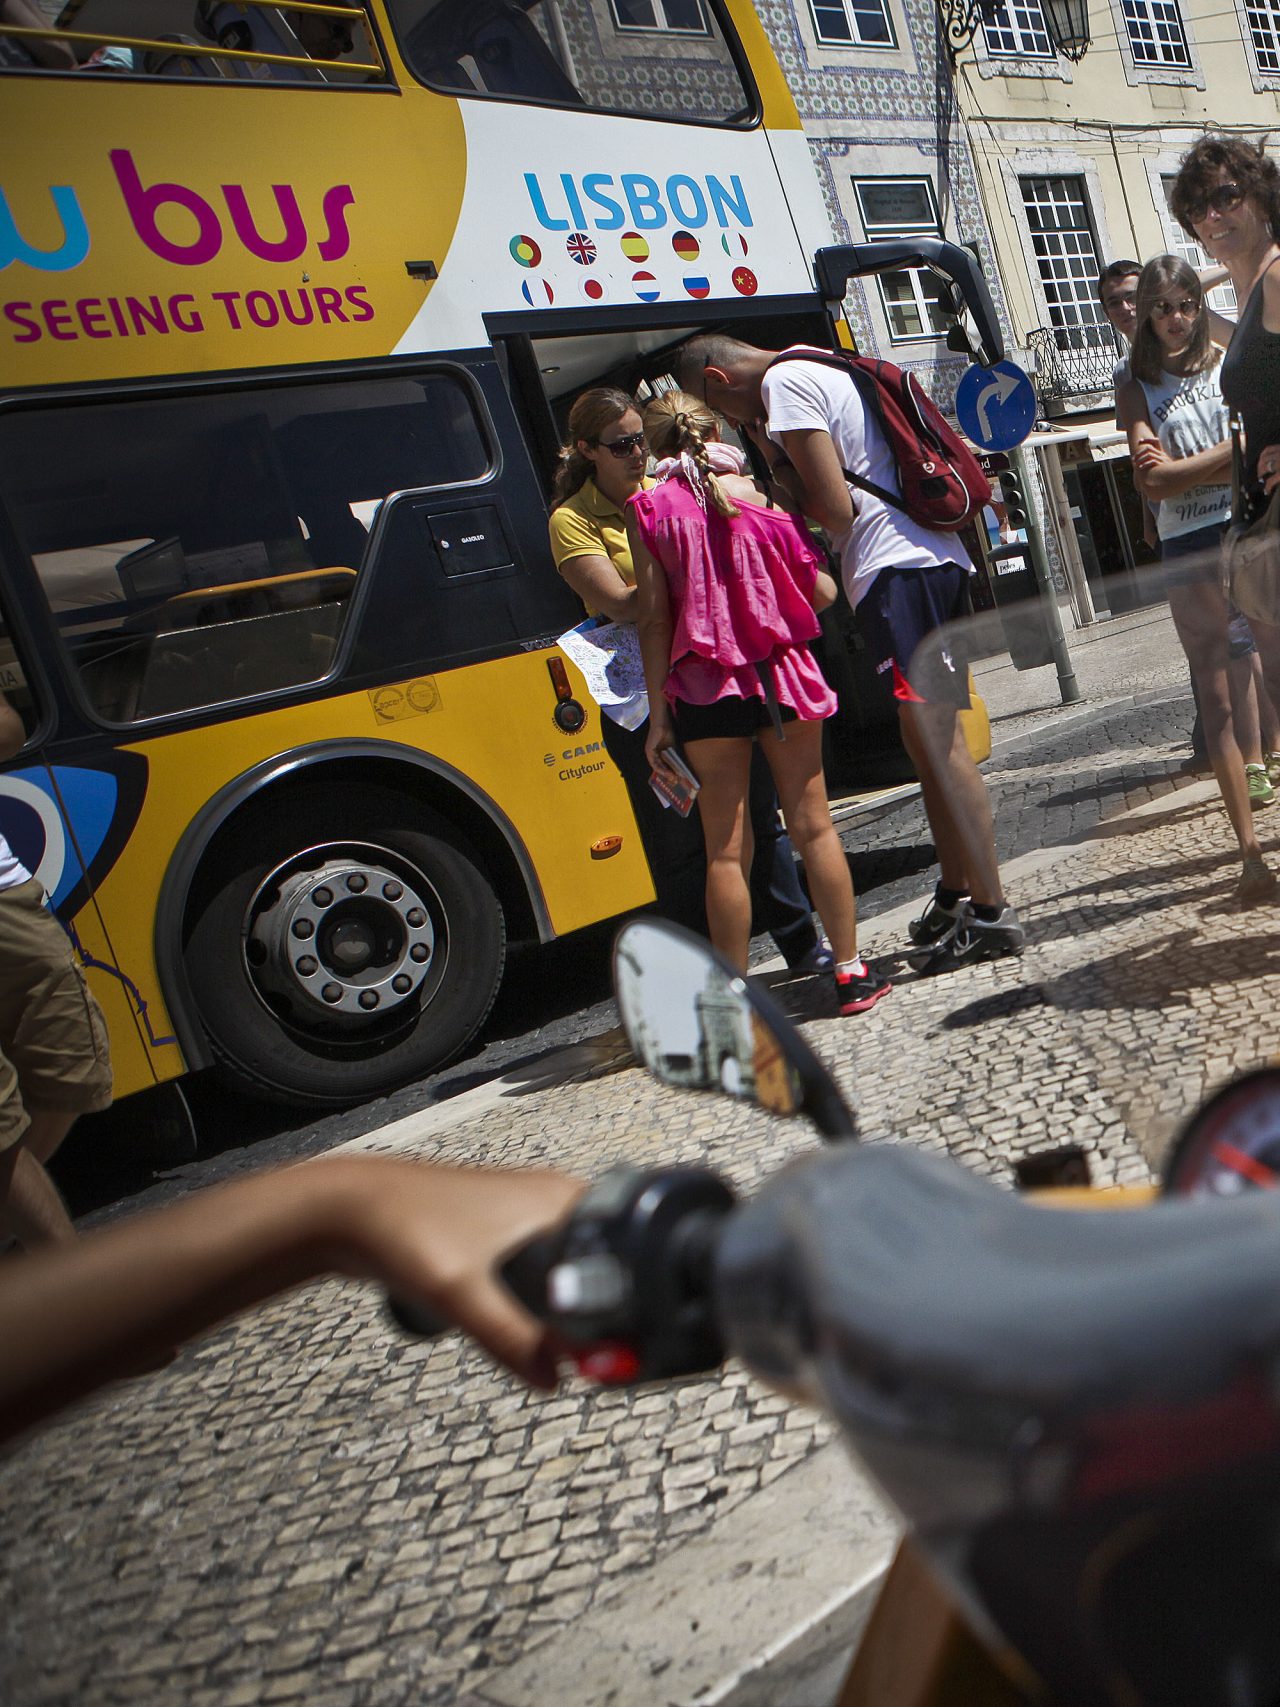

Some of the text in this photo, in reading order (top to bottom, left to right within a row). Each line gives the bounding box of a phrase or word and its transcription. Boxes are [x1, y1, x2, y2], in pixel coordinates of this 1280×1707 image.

[108, 148, 356, 266] bus
[523, 172, 754, 231] LISBON
[4, 285, 375, 343] SEEING TOURS
[1153, 383, 1222, 423] BROOKL
[559, 761, 606, 781] Citytour
